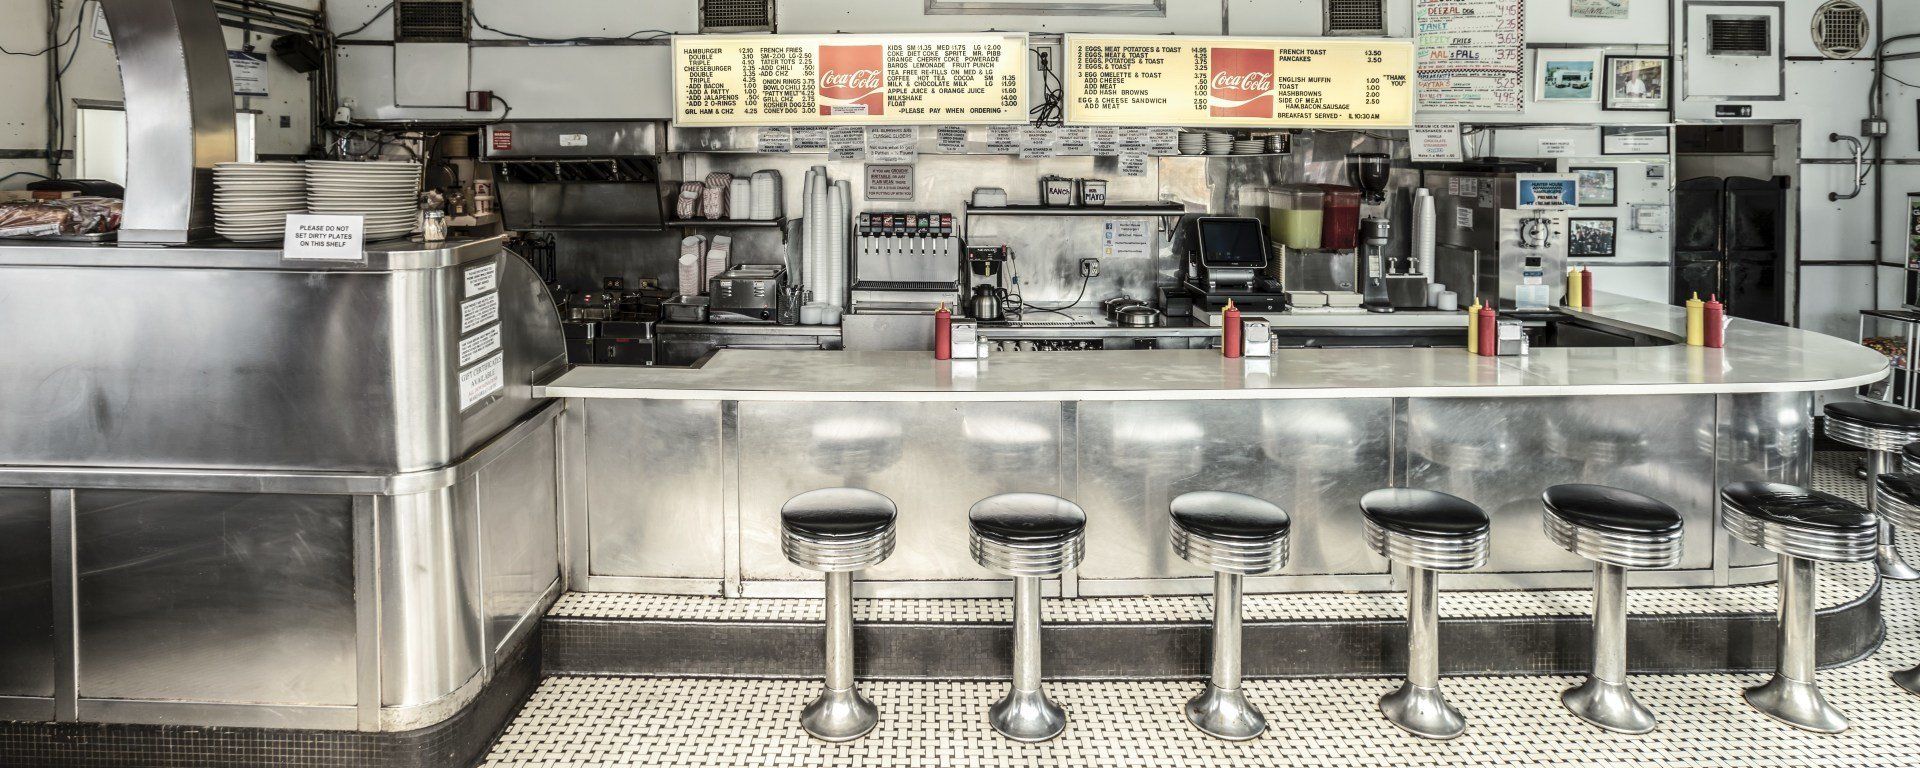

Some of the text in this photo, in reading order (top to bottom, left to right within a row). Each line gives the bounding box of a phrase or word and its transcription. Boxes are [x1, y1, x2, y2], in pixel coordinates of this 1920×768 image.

[1420, 23, 1447, 31] JANET
[820, 69, 881, 89] Coca-Cola
[1211, 70, 1272, 92] Coca-Cola
[461, 371, 473, 382] GIFT
[471, 368, 496, 386] AVAILABLE
